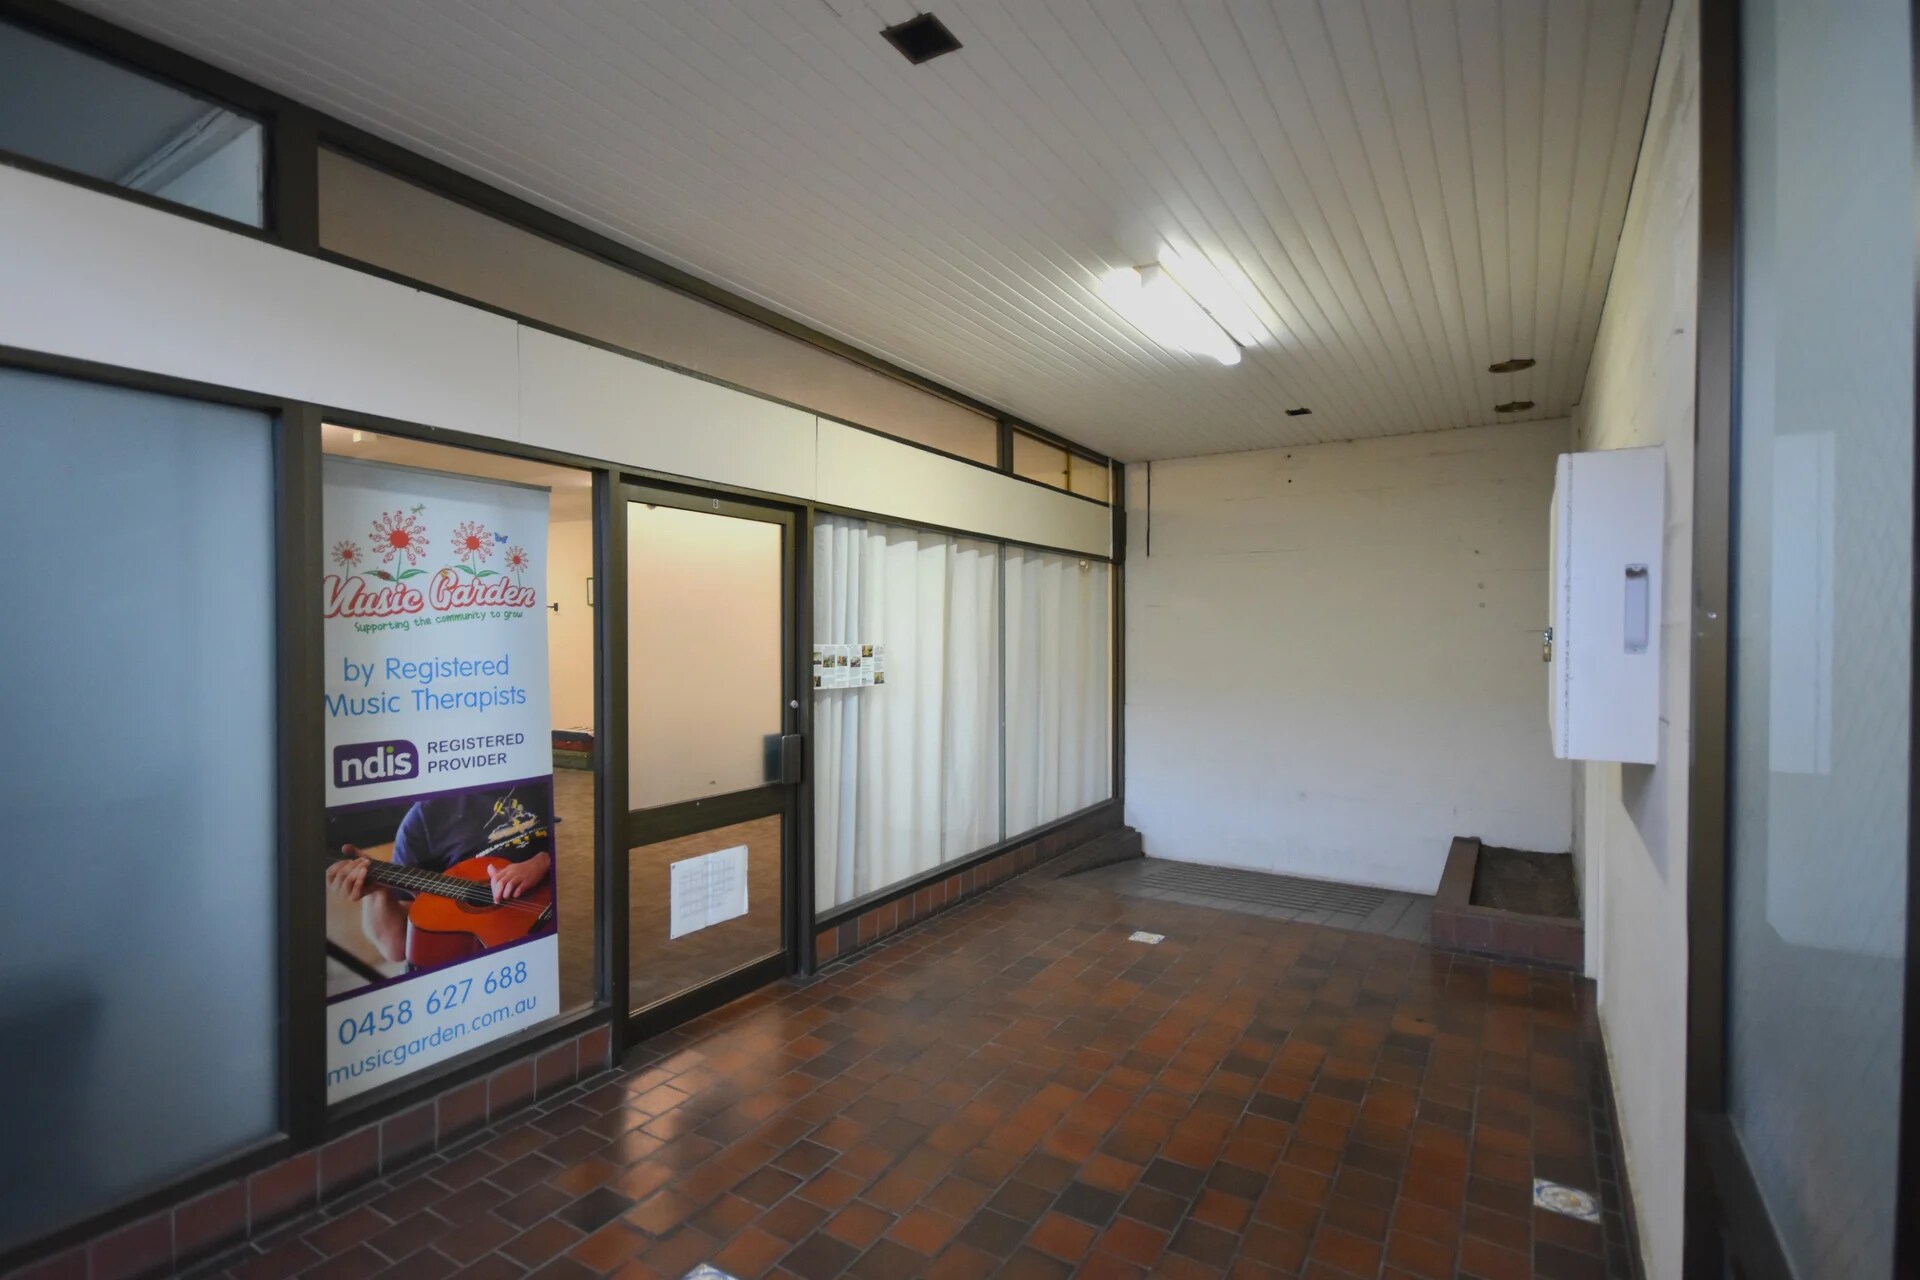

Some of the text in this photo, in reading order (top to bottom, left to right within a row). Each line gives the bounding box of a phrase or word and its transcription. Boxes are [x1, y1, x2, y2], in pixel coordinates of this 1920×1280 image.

[323, 567, 535, 618] Music Garden
[414, 616, 432, 626] the
[436, 611, 486, 623] community
[490, 610, 501, 618] to
[504, 610, 523, 620] grow
[344, 654, 509, 687] by Registered
[324, 686, 526, 717] Music Therapists
[427, 732, 525, 754] REGISTERED
[341, 746, 412, 783] ndis
[427, 752, 507, 774] PROVIDER
[338, 961, 528, 1046] 0458 627 688
[327, 996, 537, 1087] musicgarden.com.au
